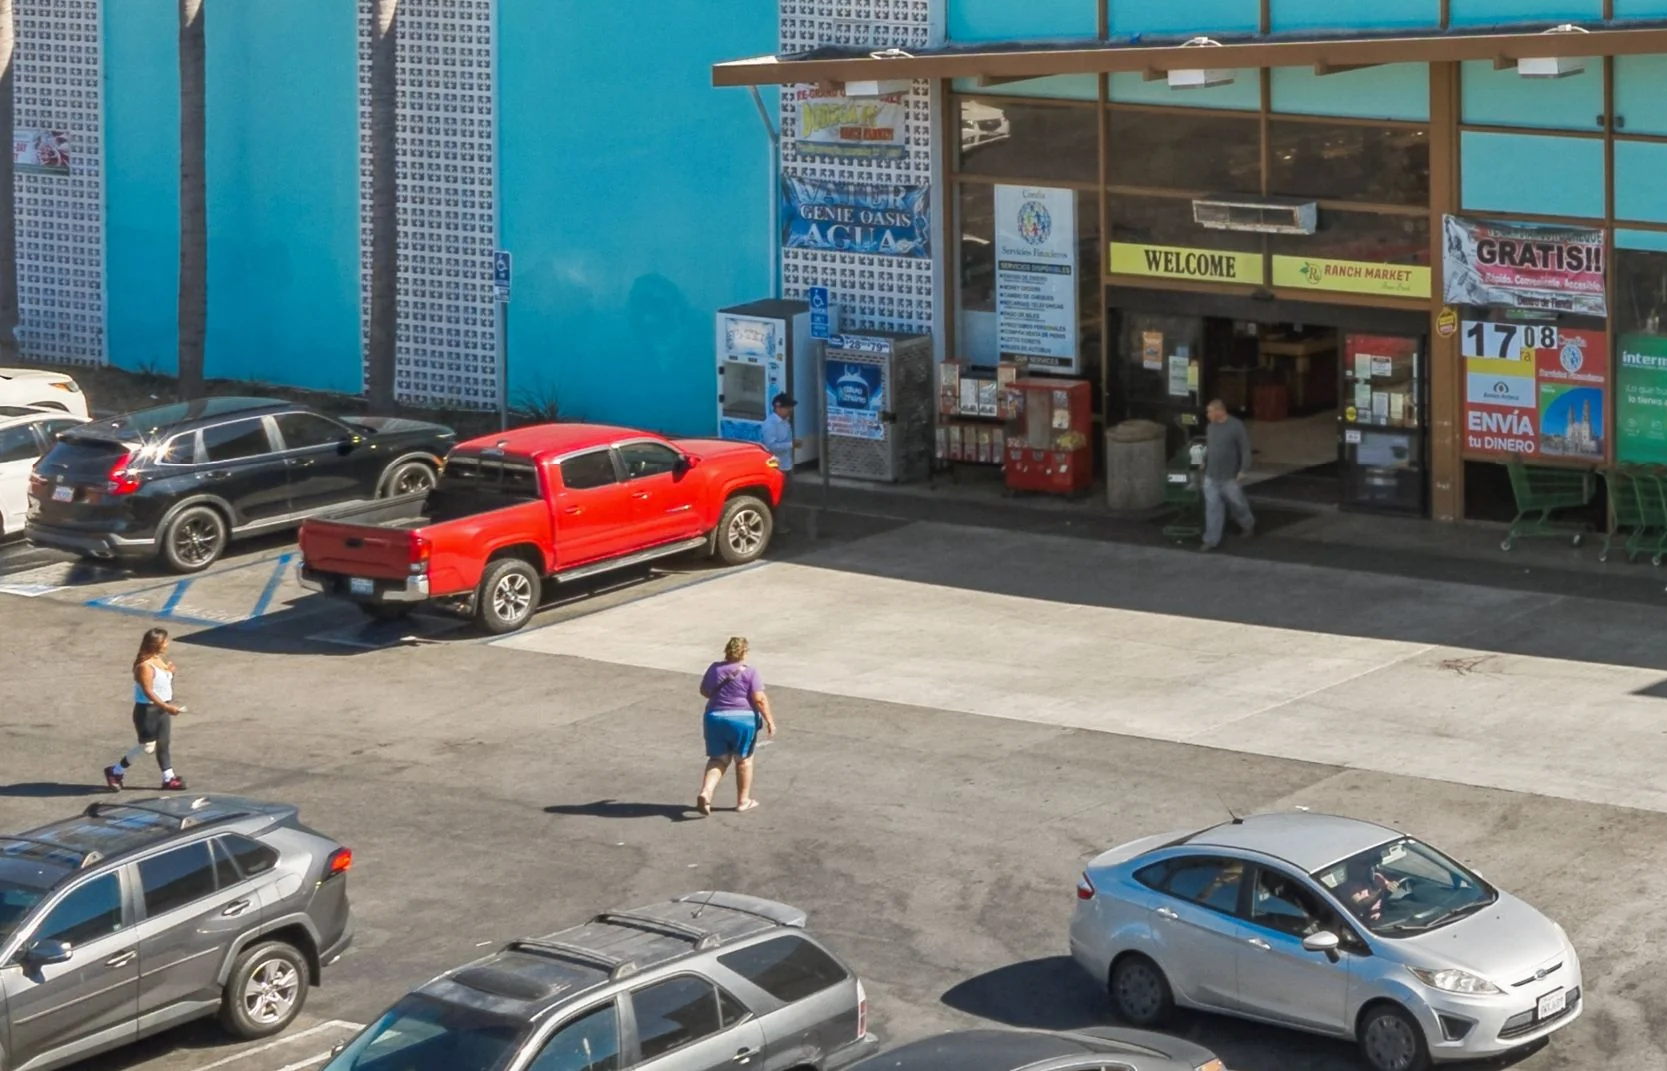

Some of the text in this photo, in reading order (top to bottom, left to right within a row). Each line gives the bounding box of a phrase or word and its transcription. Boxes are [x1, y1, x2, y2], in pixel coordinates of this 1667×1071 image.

[801, 204, 911, 227] GENIE OASIS
[804, 223, 898, 253] AGUA
[1144, 249, 1236, 278] WELCOME
[1477, 239, 1601, 272] GRATIS!!
[1324, 264, 1363, 278] RANCH
[1366, 269, 1412, 282] MARKET
[1467, 323, 1517, 358] 17
[1524, 326, 1555, 348] 08
[1468, 409, 1534, 436] ENVÍA
[1468, 435, 1534, 453] tu DINERO
